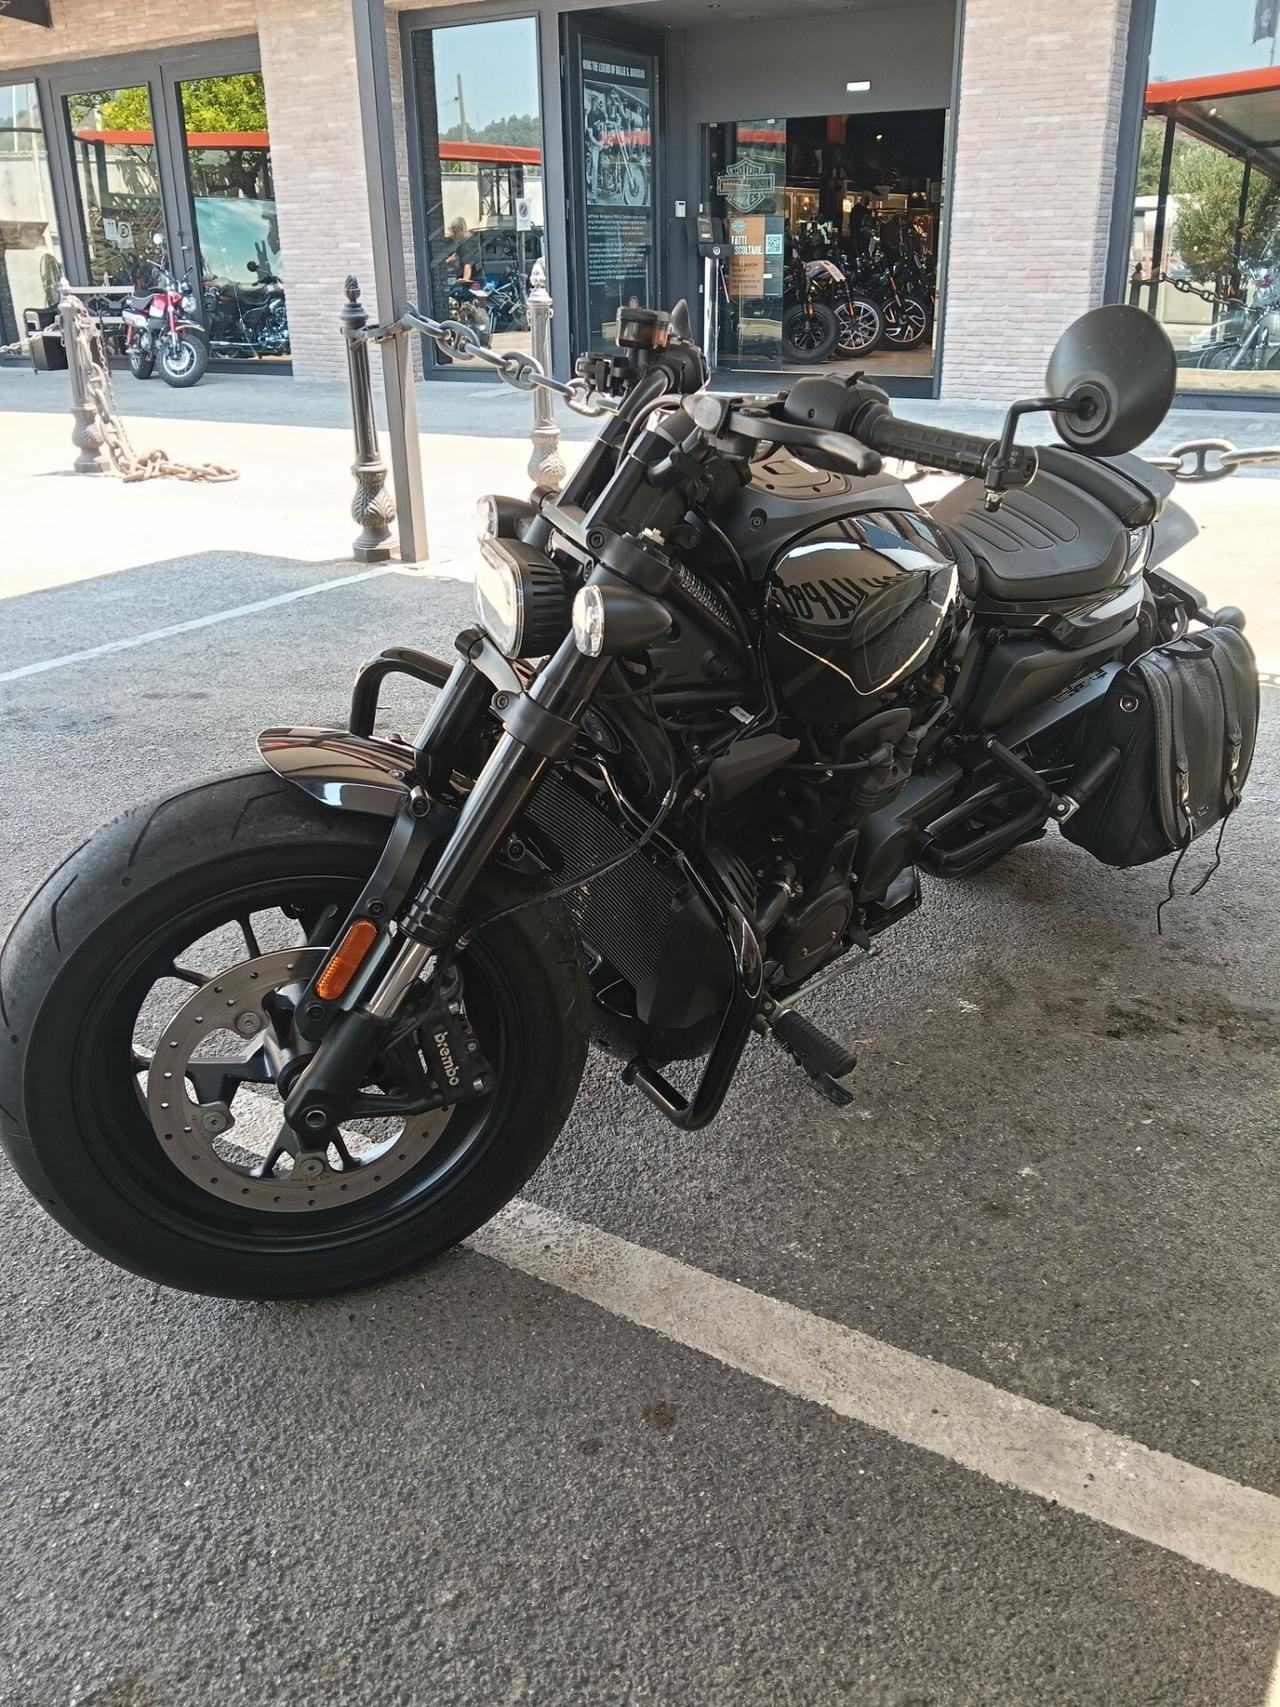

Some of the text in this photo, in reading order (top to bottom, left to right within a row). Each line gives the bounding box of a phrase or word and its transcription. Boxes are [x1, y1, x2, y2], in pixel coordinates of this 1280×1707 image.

[731, 235, 747, 245] FATTI
[733, 244, 763, 255] SCOLTARE
[434, 1031, 460, 1086] brembo
